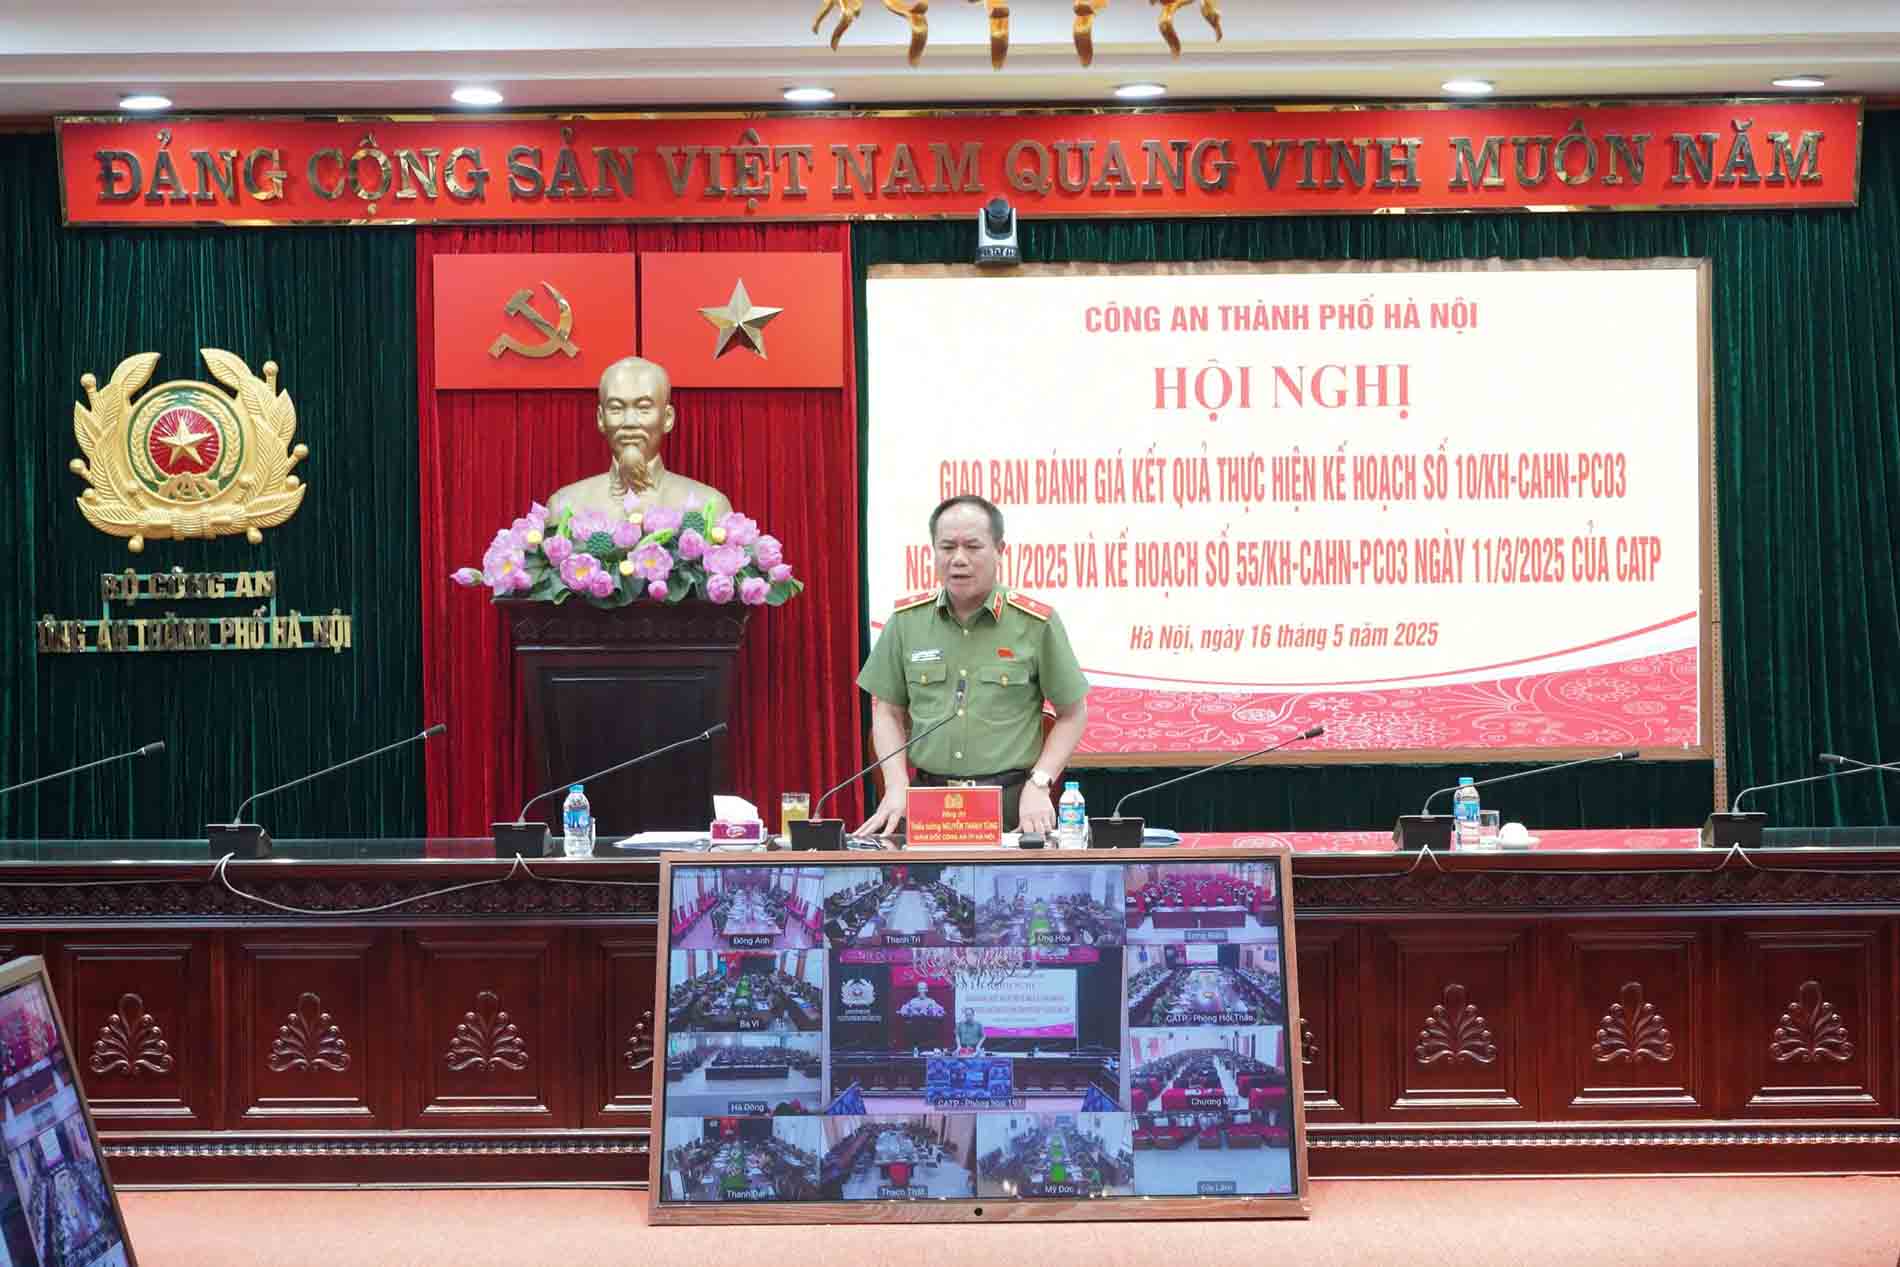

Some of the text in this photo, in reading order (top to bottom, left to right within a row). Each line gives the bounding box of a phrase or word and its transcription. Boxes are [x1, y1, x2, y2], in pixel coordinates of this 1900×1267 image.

[98, 118, 1824, 216] ĐẢNG CỘNG SẢN VIỆT NAM QUANG VINH MUÔN NĂM
[1085, 293, 1478, 335] CÔNG AN THÀNH PHỐ HÀ NỘI
[1153, 358, 1413, 423] HỘI NGHỊ
[939, 436, 1627, 513] GIAO BAN ĐÁNH GIÁ KẾT QUẢ THỰC HIỆN KẾ HOẠCH SỐ 10/KH-CAHN-PC03
[151, 565, 226, 599] CÔNG
[235, 570, 276, 598] AN
[905, 543, 946, 591] NG
[1074, 531, 1099, 589] VÀ
[1105, 527, 1129, 588] KẾ
[1135, 541, 1199, 598] HOẠCH
[1205, 522, 1230, 588] SỐ
[1236, 537, 1409, 587] 55/KH-CAHN-PC03
[1414, 527, 1466, 584] NGÀY
[1471, 536, 1566, 584] 11/3/2025
[1572, 519, 1610, 584] CỦA
[1616, 535, 1662, 583] CATP
[97, 619, 129, 651] AN
[136, 611, 209, 651] THÀNH
[220, 605, 265, 649] PHỐ
[272, 609, 303, 649] HÀ
[312, 607, 352, 654] NỘI
[1130, 622, 1154, 650] Hà
[1200, 623, 1245, 653] ngày
[1252, 624, 1272, 650] 16
[1277, 621, 1328, 652] tháng
[1333, 623, 1345, 649] 5
[1349, 622, 1390, 648] năm
[1394, 622, 1440, 648] 2025
